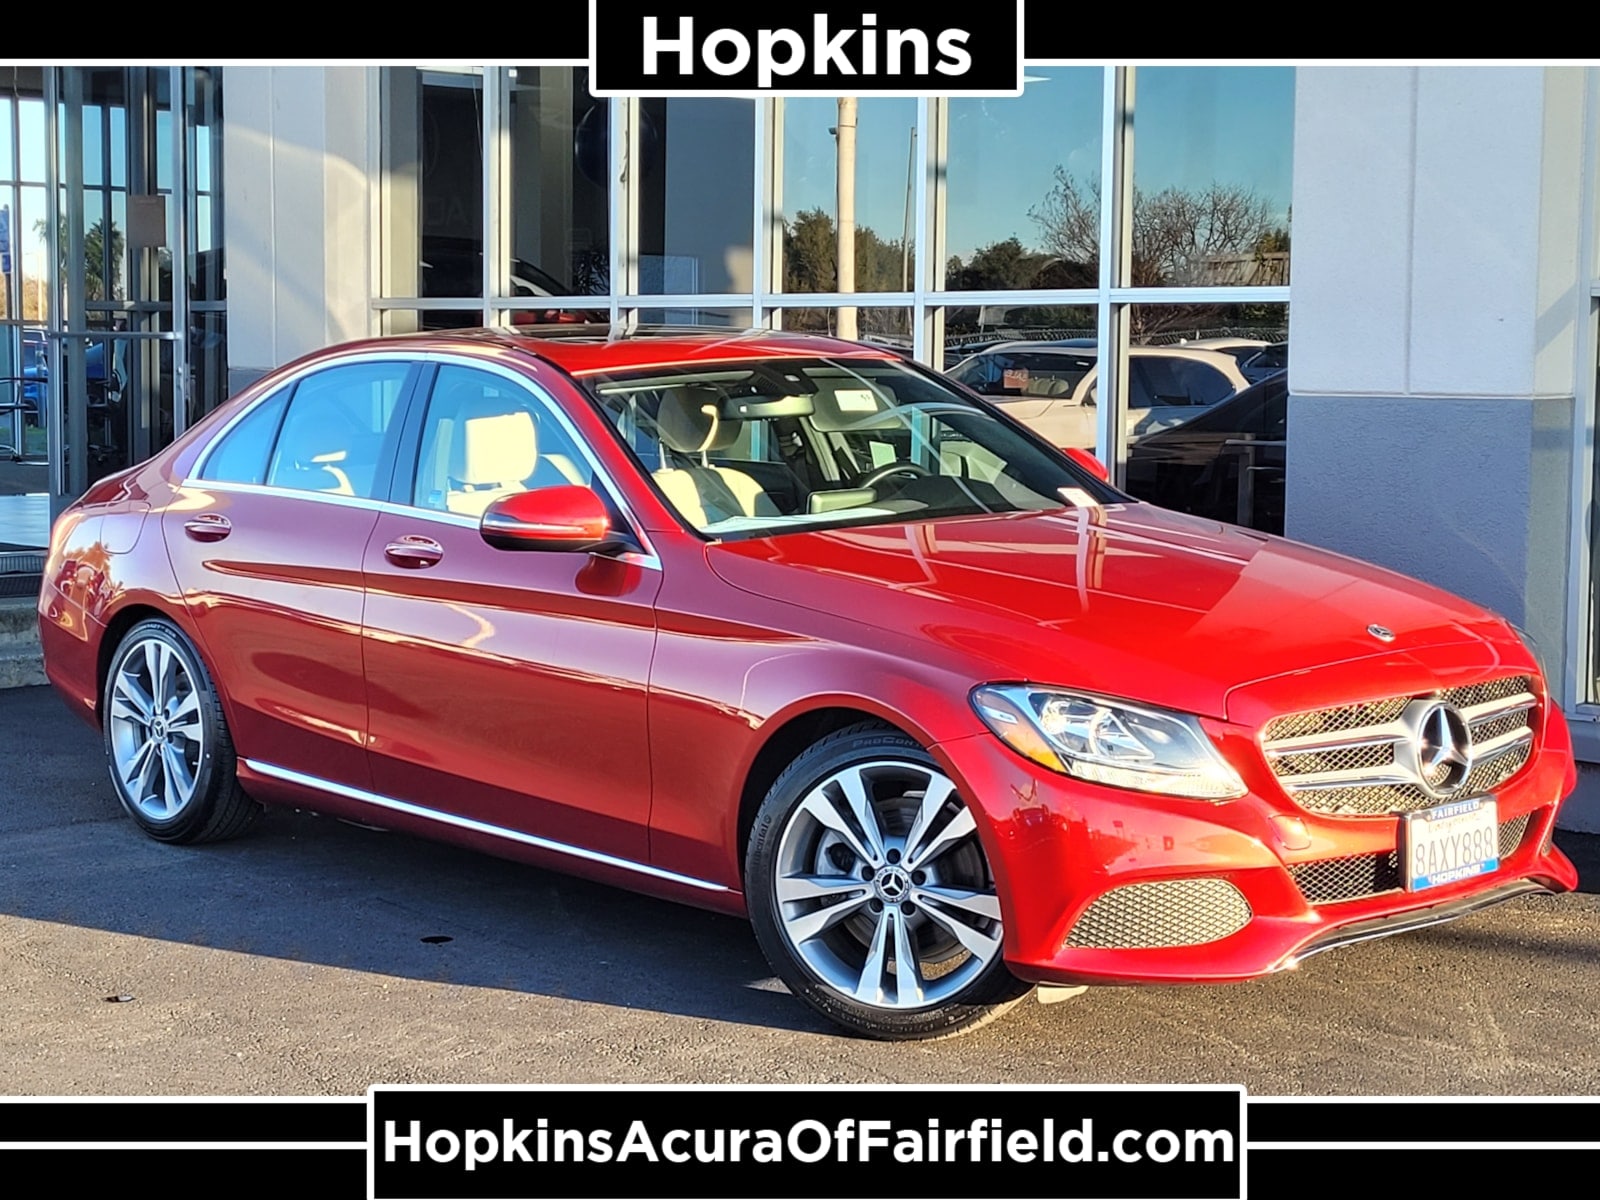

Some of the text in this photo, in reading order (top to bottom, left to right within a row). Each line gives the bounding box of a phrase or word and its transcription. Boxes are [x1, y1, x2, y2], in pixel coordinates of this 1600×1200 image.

[1432, 801, 1480, 820] FAIRFIELD
[1415, 826, 1494, 876] 8AXY888
[1431, 864, 1481, 885] HOPKINS
